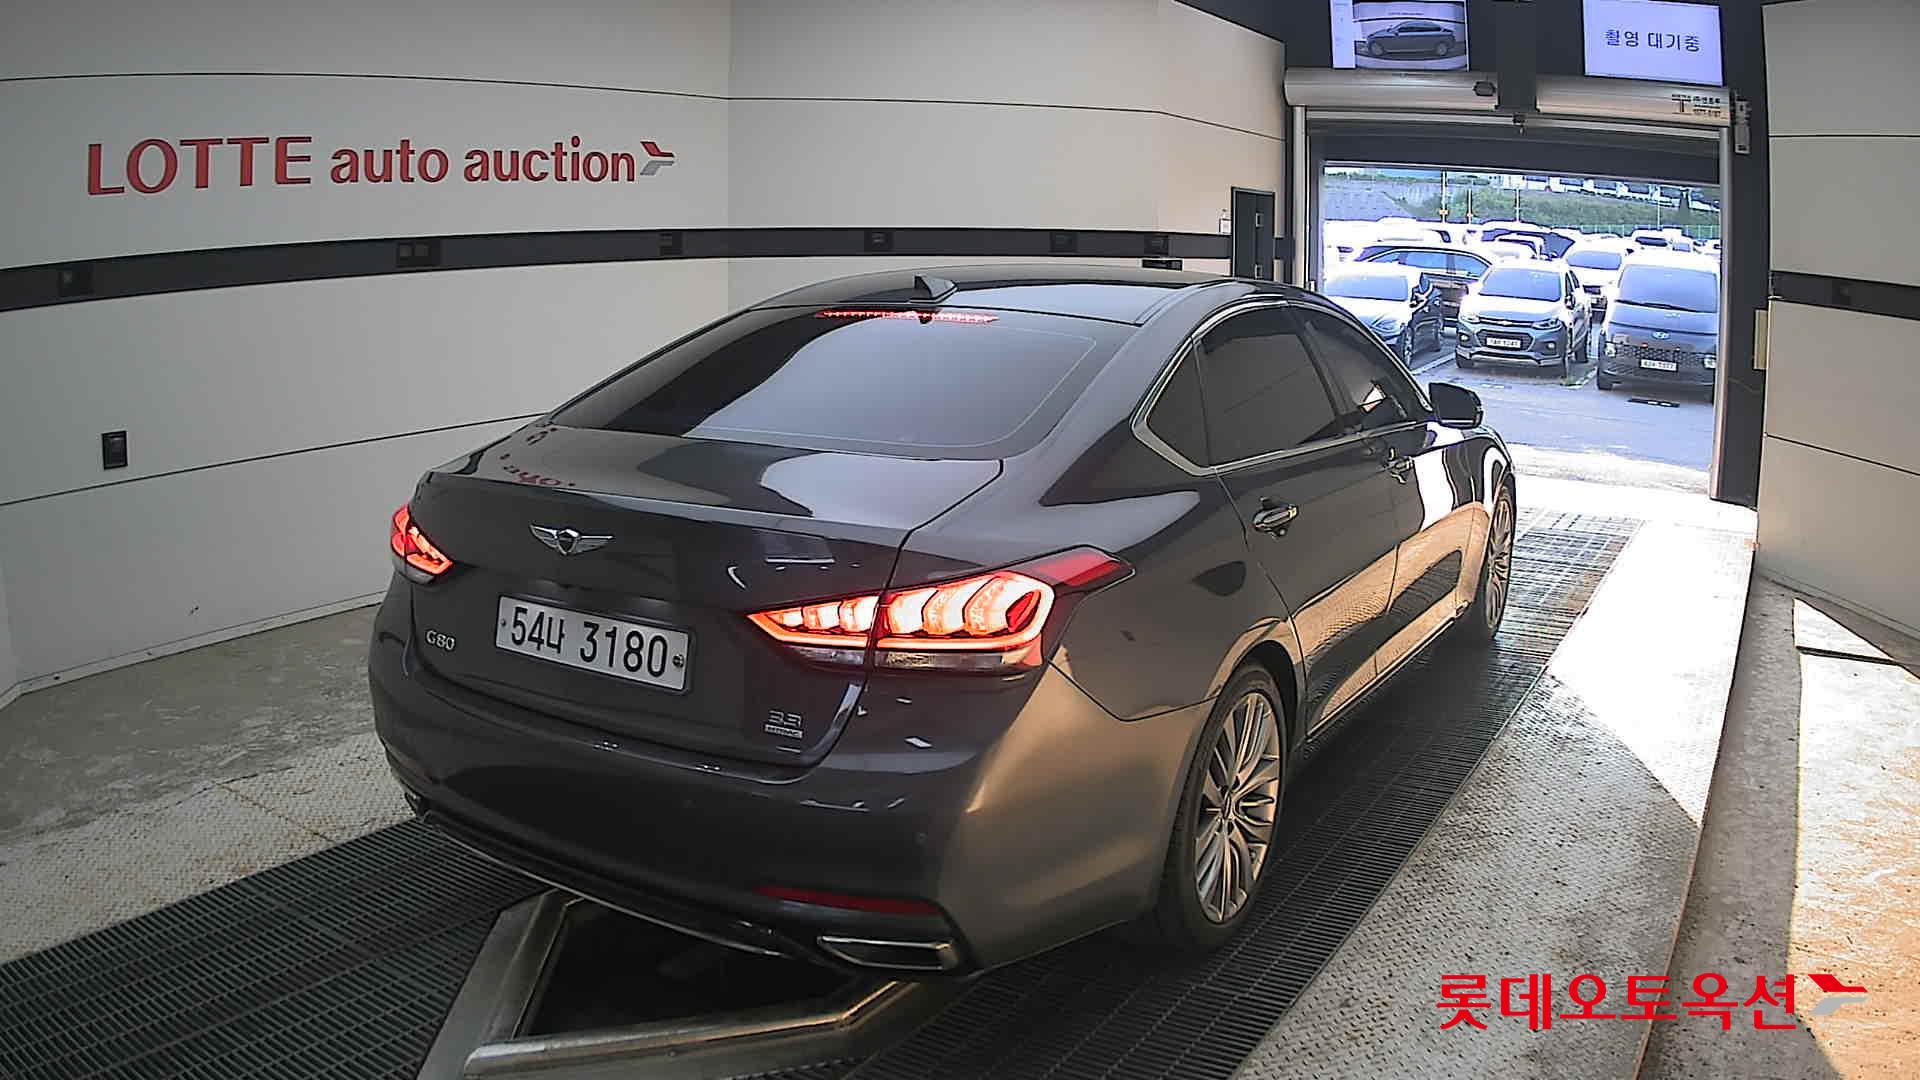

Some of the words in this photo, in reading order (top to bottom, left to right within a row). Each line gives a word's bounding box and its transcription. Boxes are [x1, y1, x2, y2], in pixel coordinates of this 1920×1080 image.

[1605, 29, 1639, 47] 촬영
[1647, 32, 1700, 52] 대기중
[88, 136, 312, 195] LOTTE
[330, 138, 449, 184] auto
[463, 135, 636, 182] auction
[426, 630, 455, 650] G80
[511, 606, 565, 654] 54나
[580, 621, 668, 678] 3180
